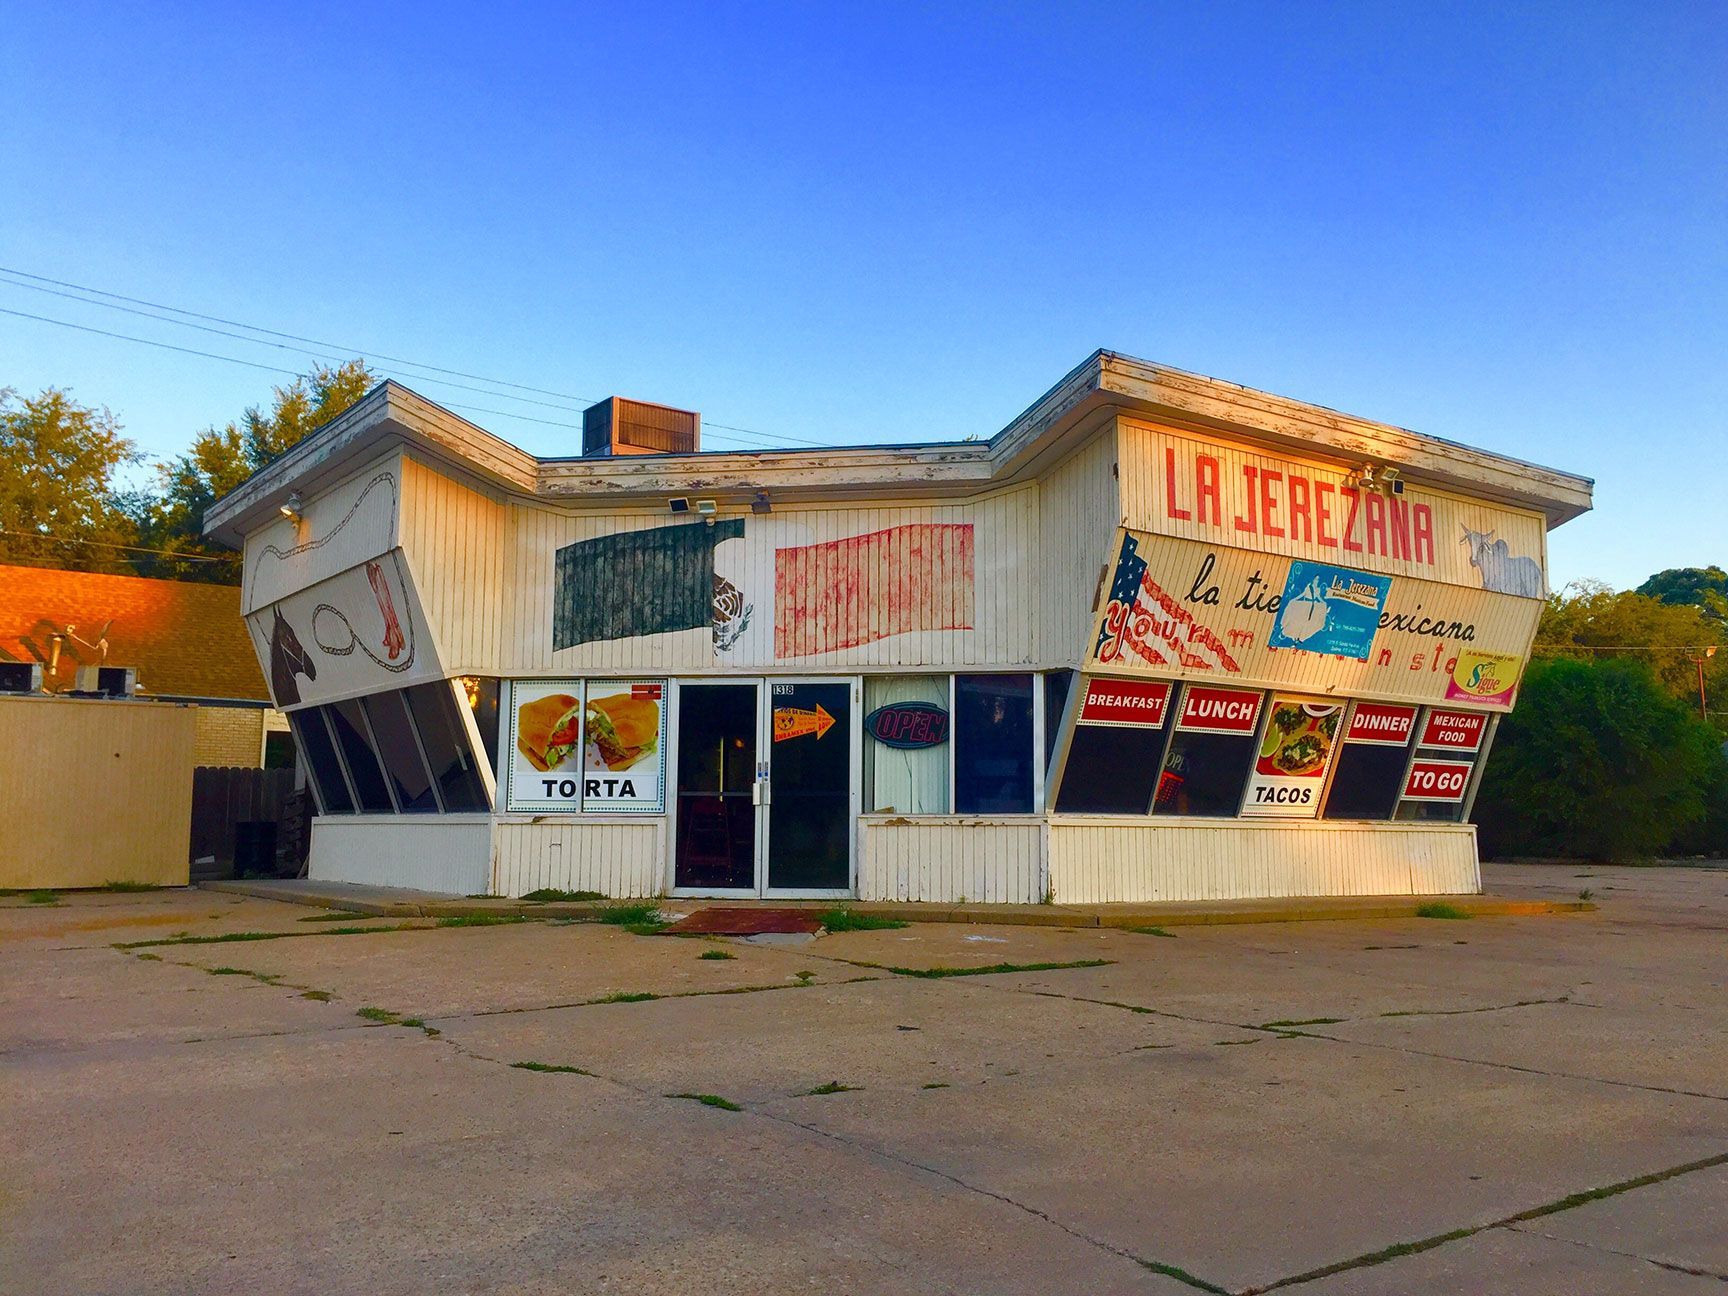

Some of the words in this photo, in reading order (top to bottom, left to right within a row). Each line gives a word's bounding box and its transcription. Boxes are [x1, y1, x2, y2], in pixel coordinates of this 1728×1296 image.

[1166, 447, 1221, 526] LA
[1235, 464, 1434, 565] JEREZANA
[1184, 553, 1220, 605] la
[1234, 570, 1282, 614] tie
[1377, 604, 1475, 641] exicana
[1466, 663, 1501, 695] Sigue
[773, 685, 794, 695] 1318
[1088, 694, 1162, 710] BREAKFAST
[1186, 699, 1253, 721] LUNCH
[876, 710, 947, 743] OPEN
[1353, 713, 1410, 732] DINNER
[1433, 715, 1479, 730] MEXICAN
[1438, 730, 1466, 743] FOOD
[542, 779, 636, 798] TORTA
[1413, 771, 1435, 789] TO
[1437, 772, 1463, 790] GO
[1255, 786, 1312, 804] TACOS
